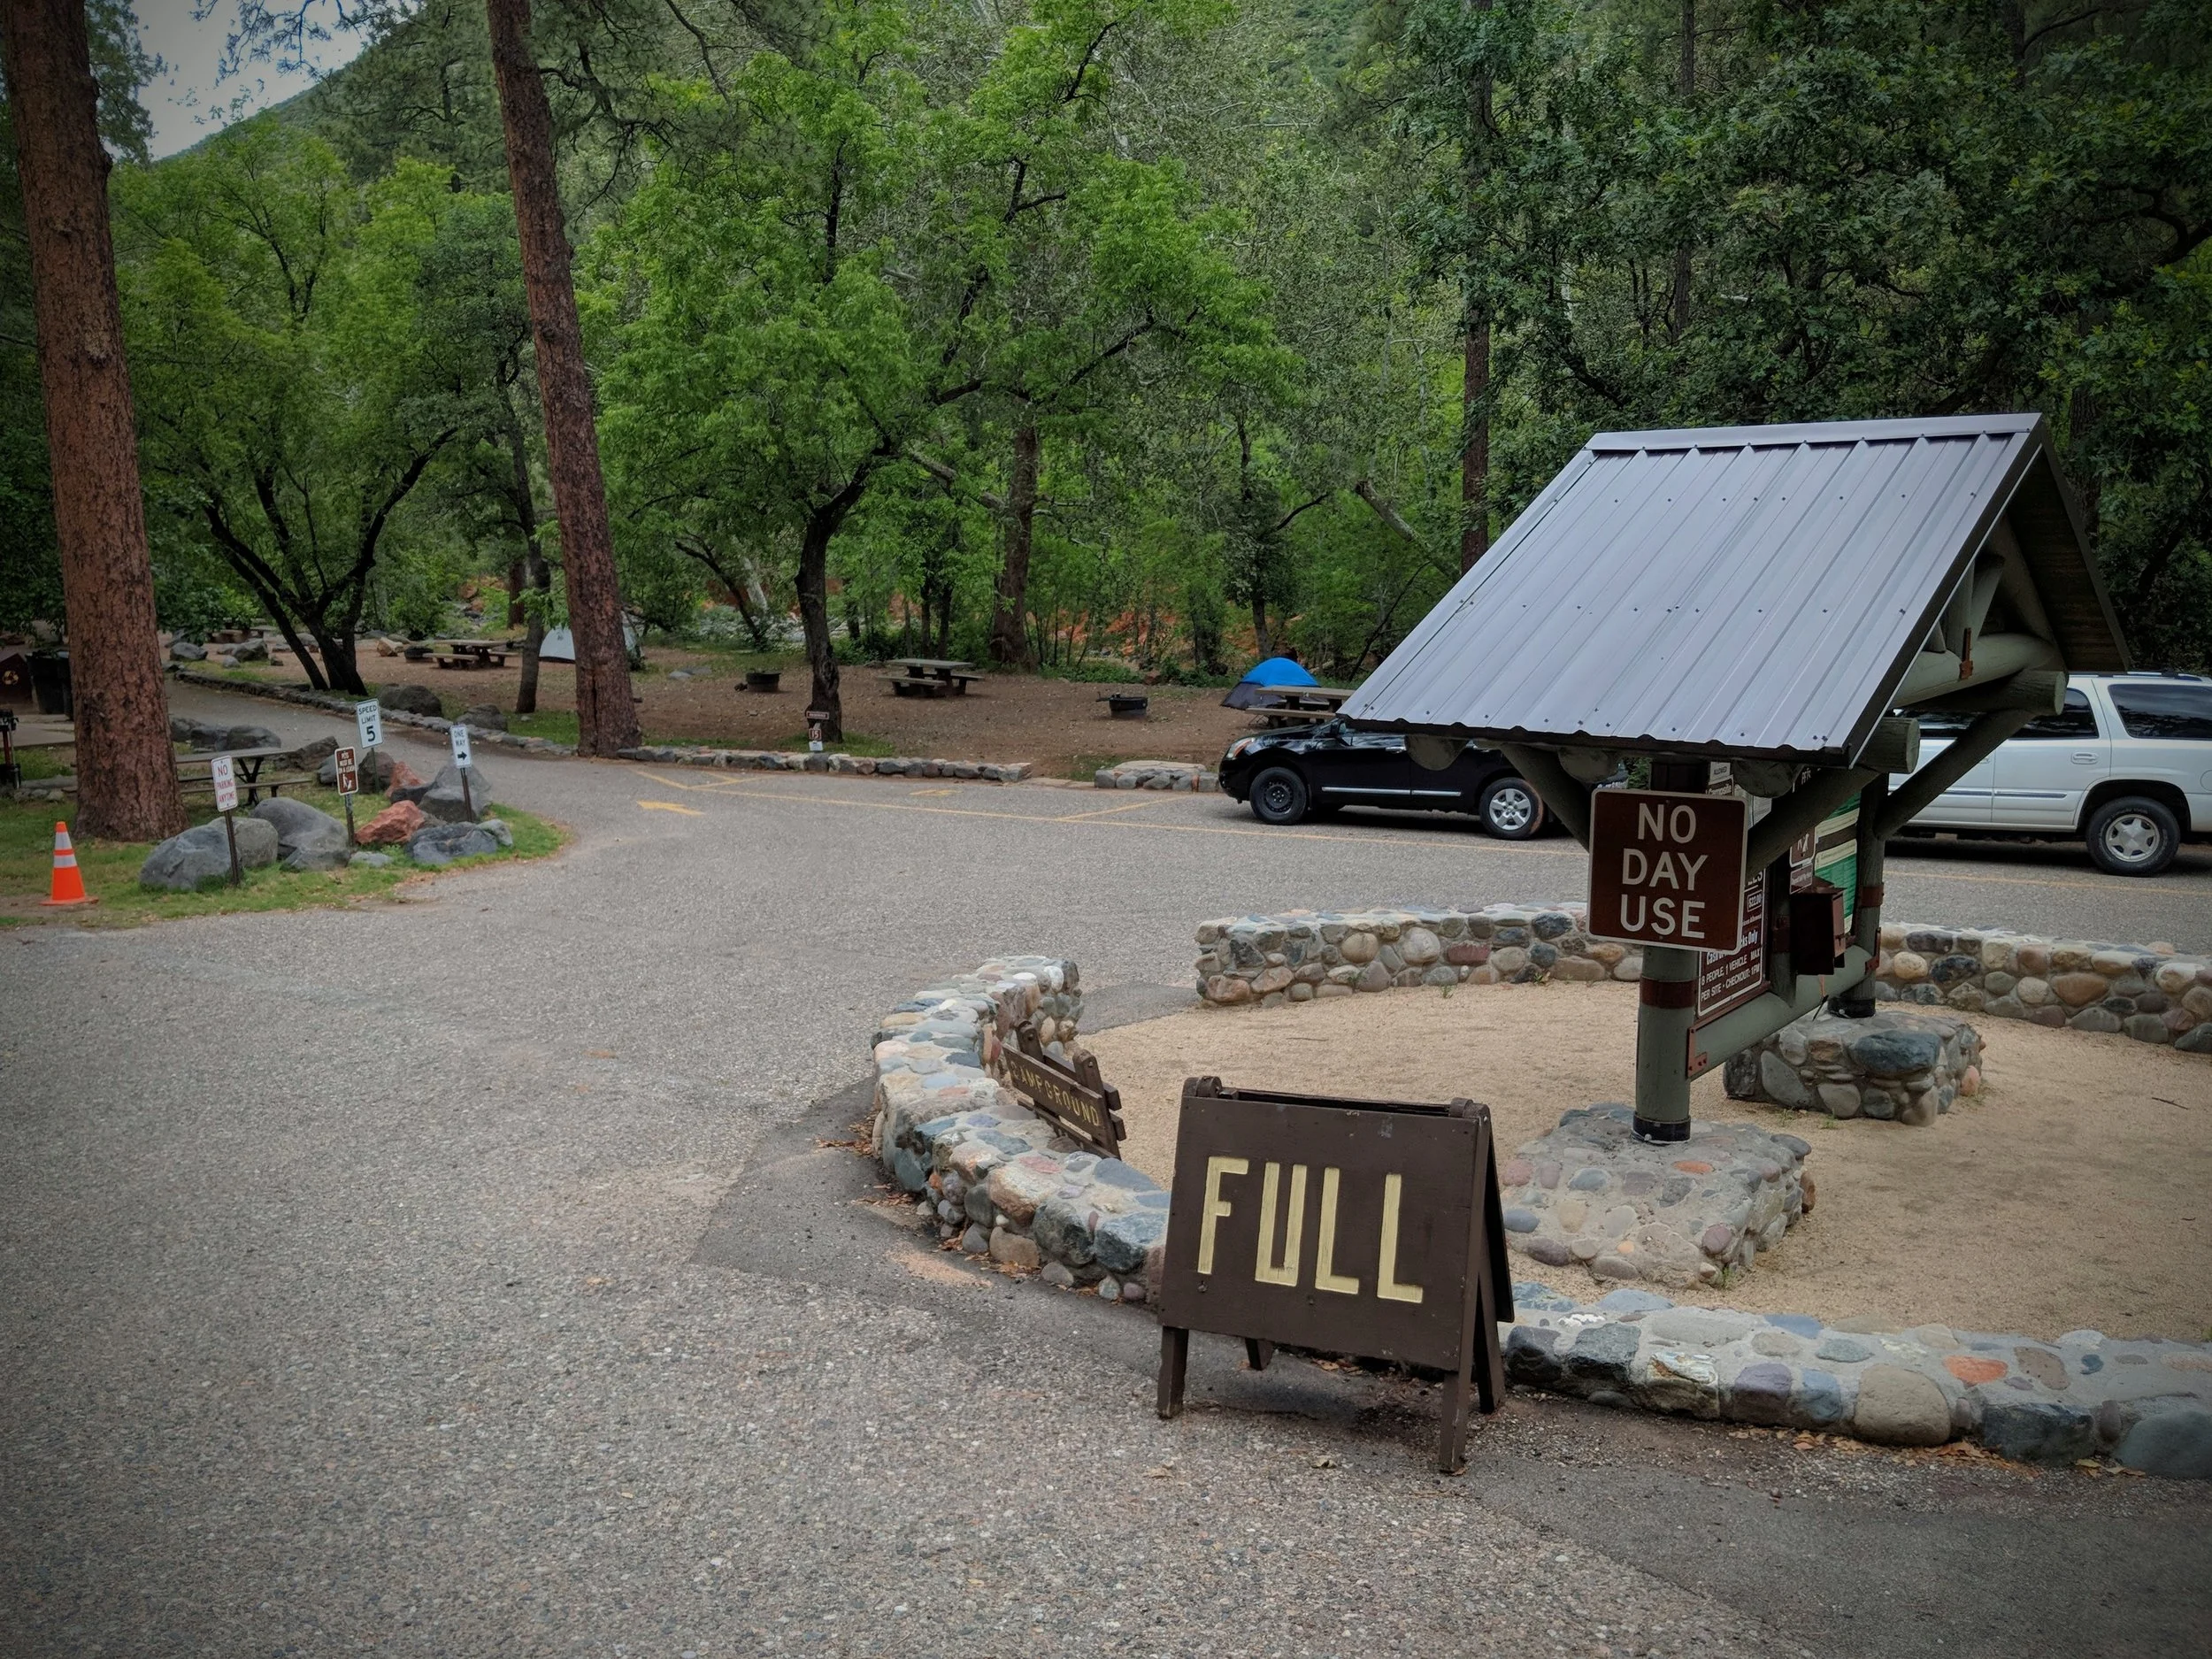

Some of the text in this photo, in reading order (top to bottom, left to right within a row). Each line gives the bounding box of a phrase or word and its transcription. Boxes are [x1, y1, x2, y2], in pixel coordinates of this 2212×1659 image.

[358, 704, 377, 715] SPEED
[361, 714, 376, 725] LIMIT
[366, 726, 376, 742] 5
[454, 729, 465, 738] ONE
[218, 764, 228, 777] NO
[217, 780, 234, 789] PARKING
[219, 792, 234, 803] ANYTIME
[1638, 803, 1696, 844] NO
[1622, 849, 1709, 891] DAY
[1620, 894, 1705, 940] USE
[1748, 929, 1758, 945] Only
[1701, 975, 1706, 986] 8
[1729, 954, 1747, 972] VEHICLE
[1750, 948, 1761, 961] MAX
[1701, 989, 1710, 1002] PER
[1711, 983, 1722, 996] SITE
[1751, 963, 1761, 975] 1PM
[1010, 1061, 1099, 1126] CAMPGROUND
[1197, 1156, 1424, 1304] FULL
